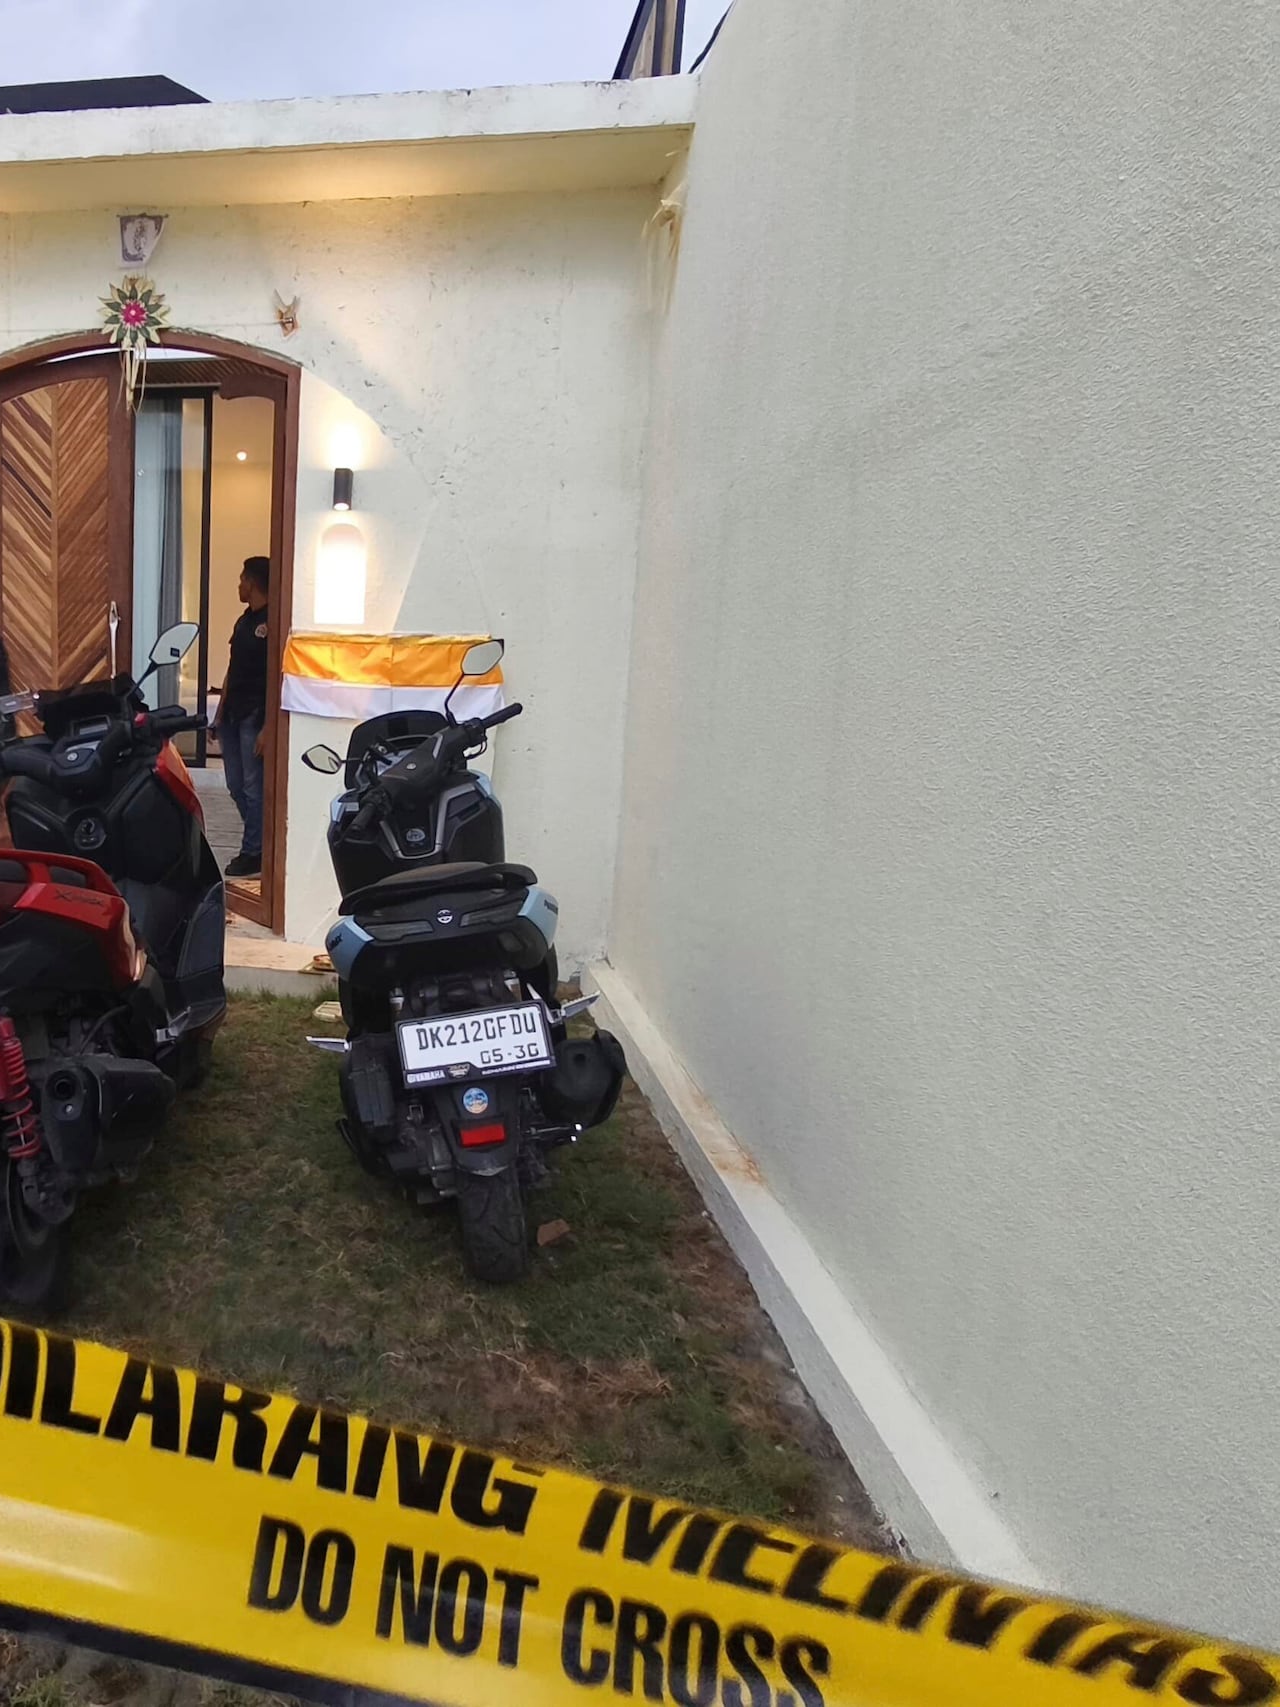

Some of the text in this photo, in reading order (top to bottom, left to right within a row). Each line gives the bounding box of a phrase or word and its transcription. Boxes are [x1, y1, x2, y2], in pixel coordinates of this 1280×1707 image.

[248, 1514, 832, 1707] DO NOT CROSS
